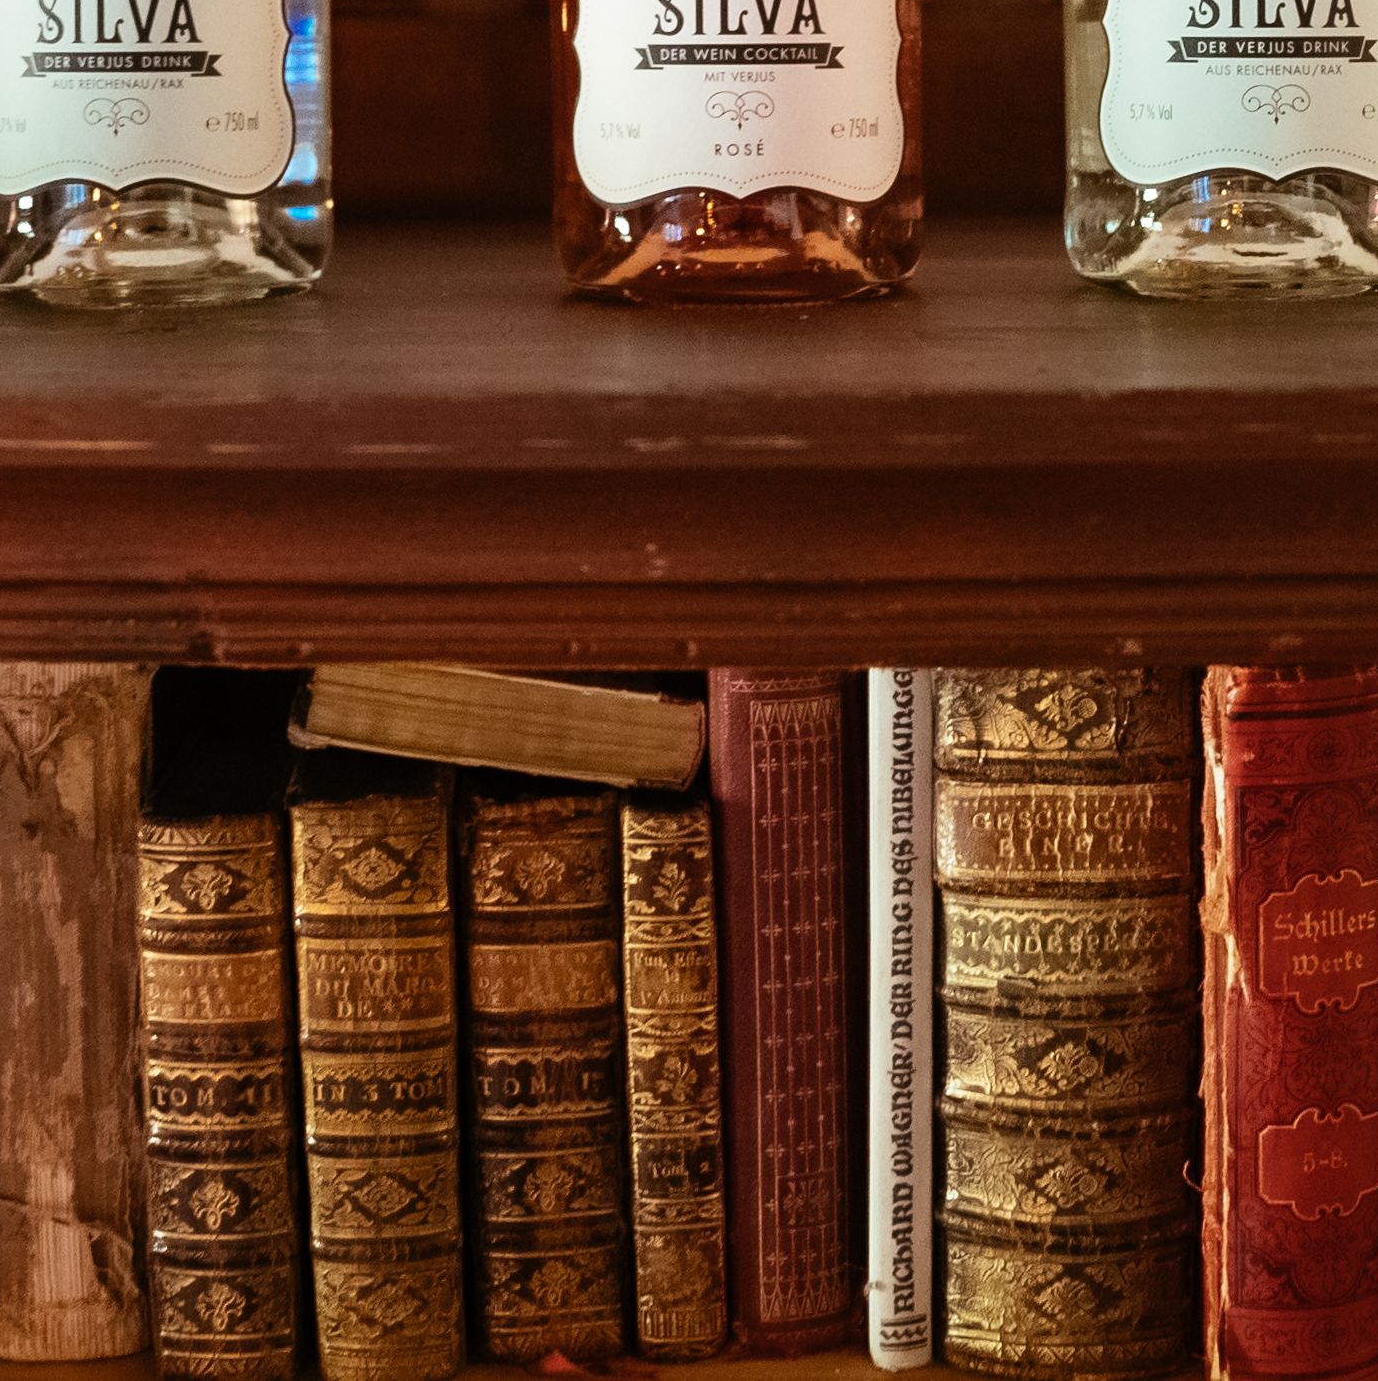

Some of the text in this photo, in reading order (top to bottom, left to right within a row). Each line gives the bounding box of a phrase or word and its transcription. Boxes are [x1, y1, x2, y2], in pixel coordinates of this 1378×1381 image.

[658, 46, 819, 62] DER WEIN COCKTAIL
[1196, 39, 1351, 55] DER VERJUS DRINK
[42, 54, 193, 70] DER VERJUS DRINK
[1205, 63, 1233, 76] AUS
[52, 78, 75, 90] AUS
[703, 71, 777, 83] MIT VERJUS
[223, 112, 245, 132] 750
[848, 118, 868, 139] 750
[868, 116, 880, 138] ml
[714, 139, 766, 157] ROSÉ
[1272, 908, 1378, 944] Schillers
[1292, 951, 1365, 977] Werke
[314, 1082, 347, 1103] IN
